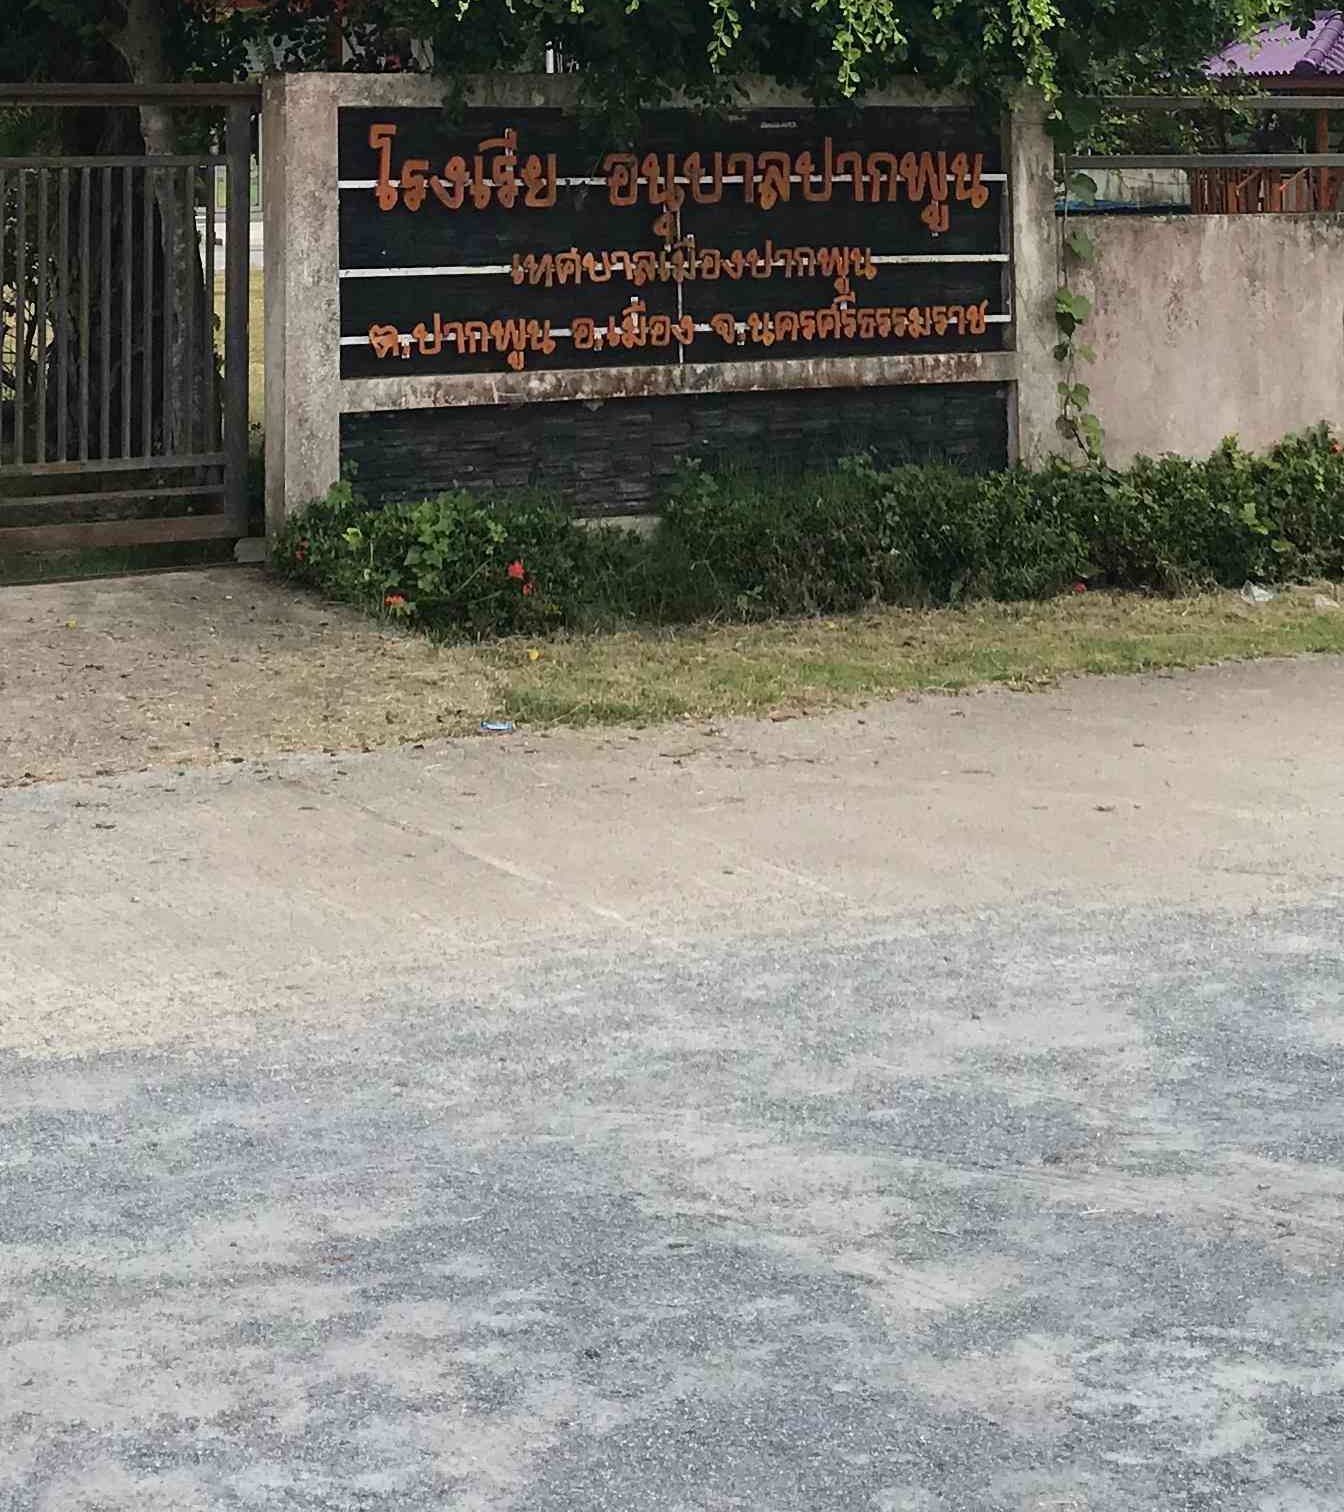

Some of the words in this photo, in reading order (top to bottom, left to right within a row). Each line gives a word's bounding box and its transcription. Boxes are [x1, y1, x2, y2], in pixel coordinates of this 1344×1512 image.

[603, 136, 989, 236] อนุบาลปากพูน
